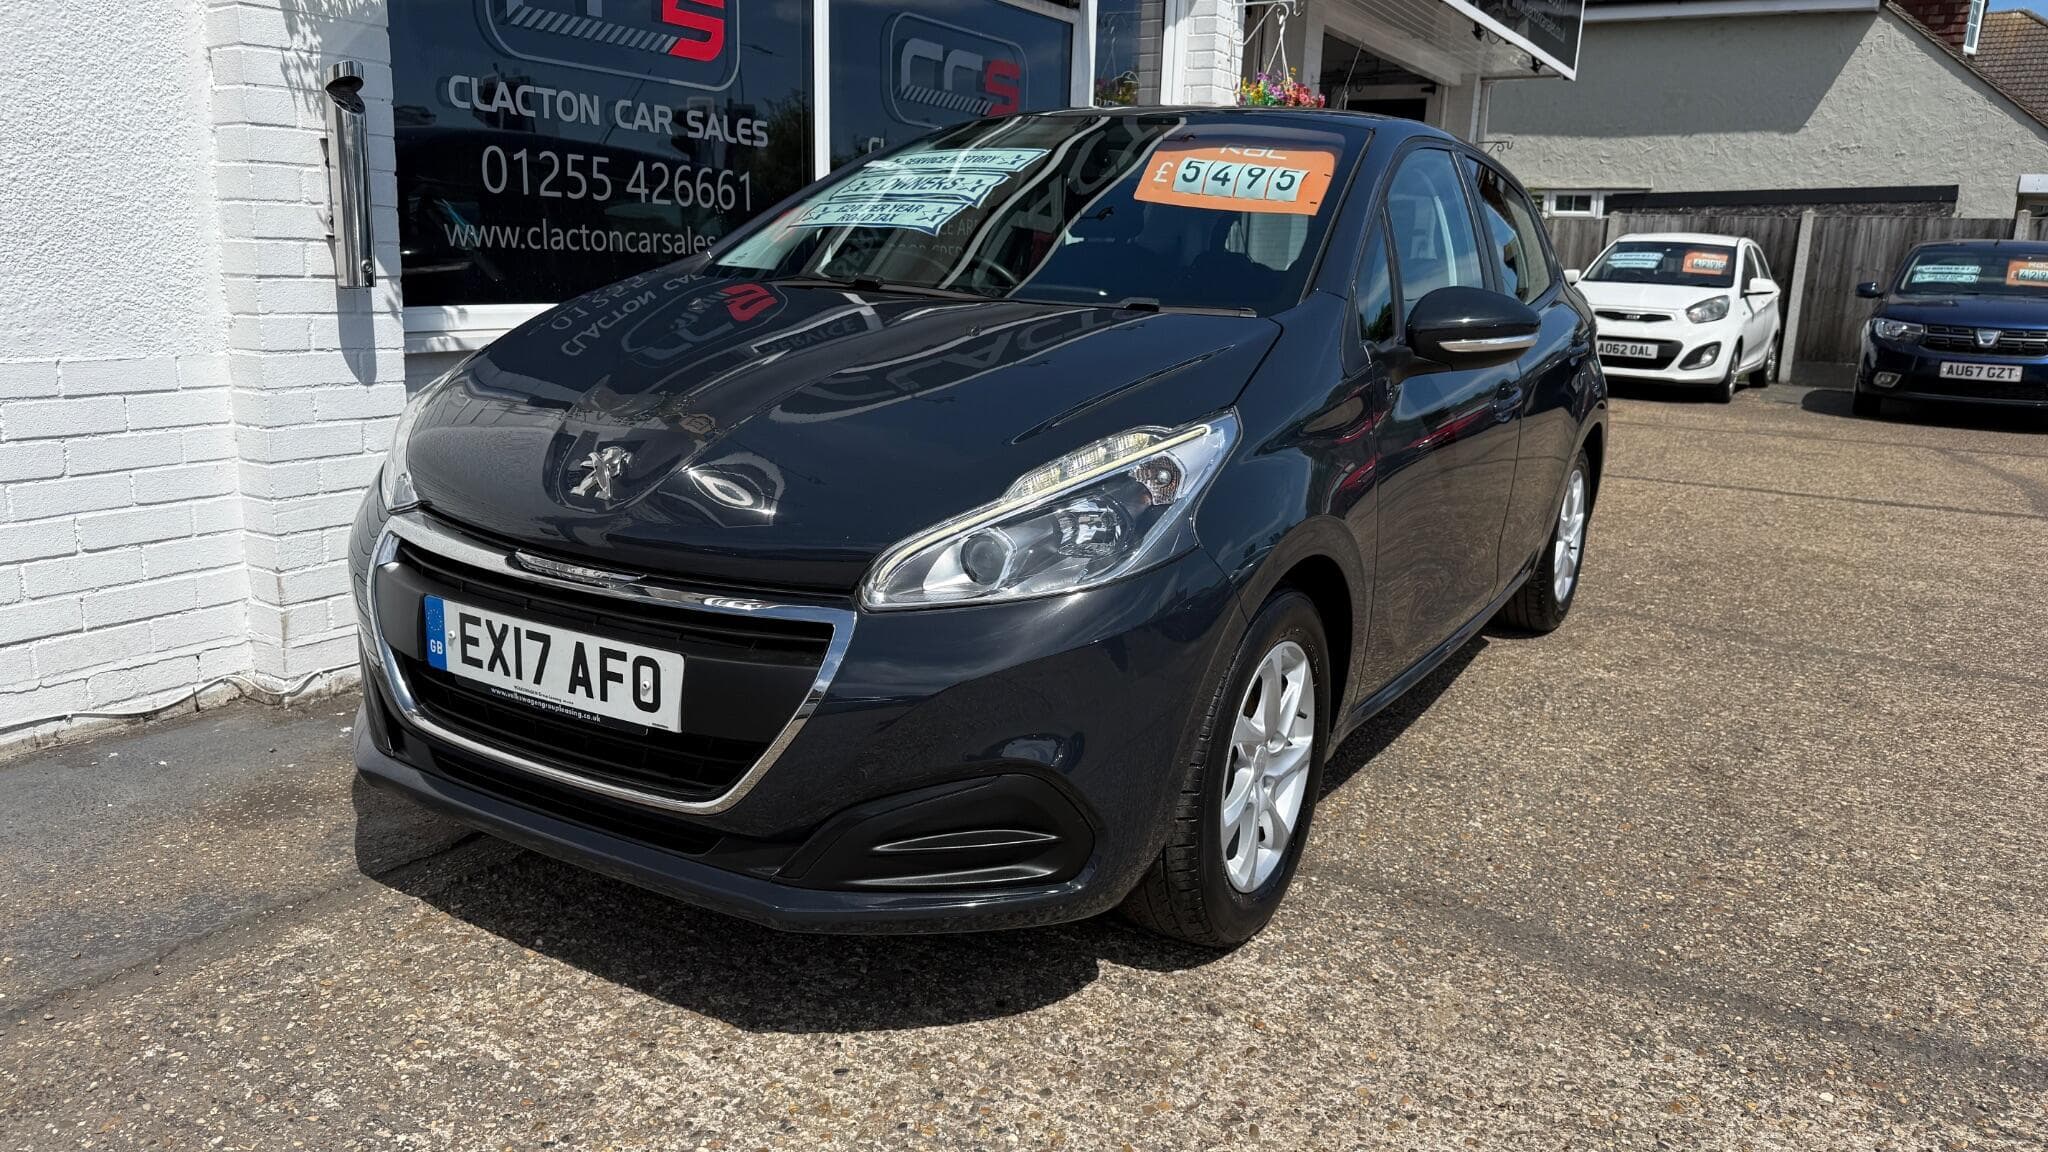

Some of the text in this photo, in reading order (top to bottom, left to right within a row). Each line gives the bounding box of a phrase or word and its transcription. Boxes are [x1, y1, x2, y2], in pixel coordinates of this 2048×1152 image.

[448, 74, 769, 149] CLACTON CAR SALES
[946, 155, 1000, 164] HSTORY
[481, 145, 751, 212] 01255 426661
[1181, 160, 1300, 191] 5495
[879, 177, 965, 191] OWNERS
[889, 203, 925, 213] YEAR
[873, 213, 900, 222] TAX
[1630, 343, 1653, 357] OAL
[1946, 364, 2016, 379] AU67 GZT
[429, 639, 443, 655] GB
[459, 612, 661, 714] EX17 AFO
